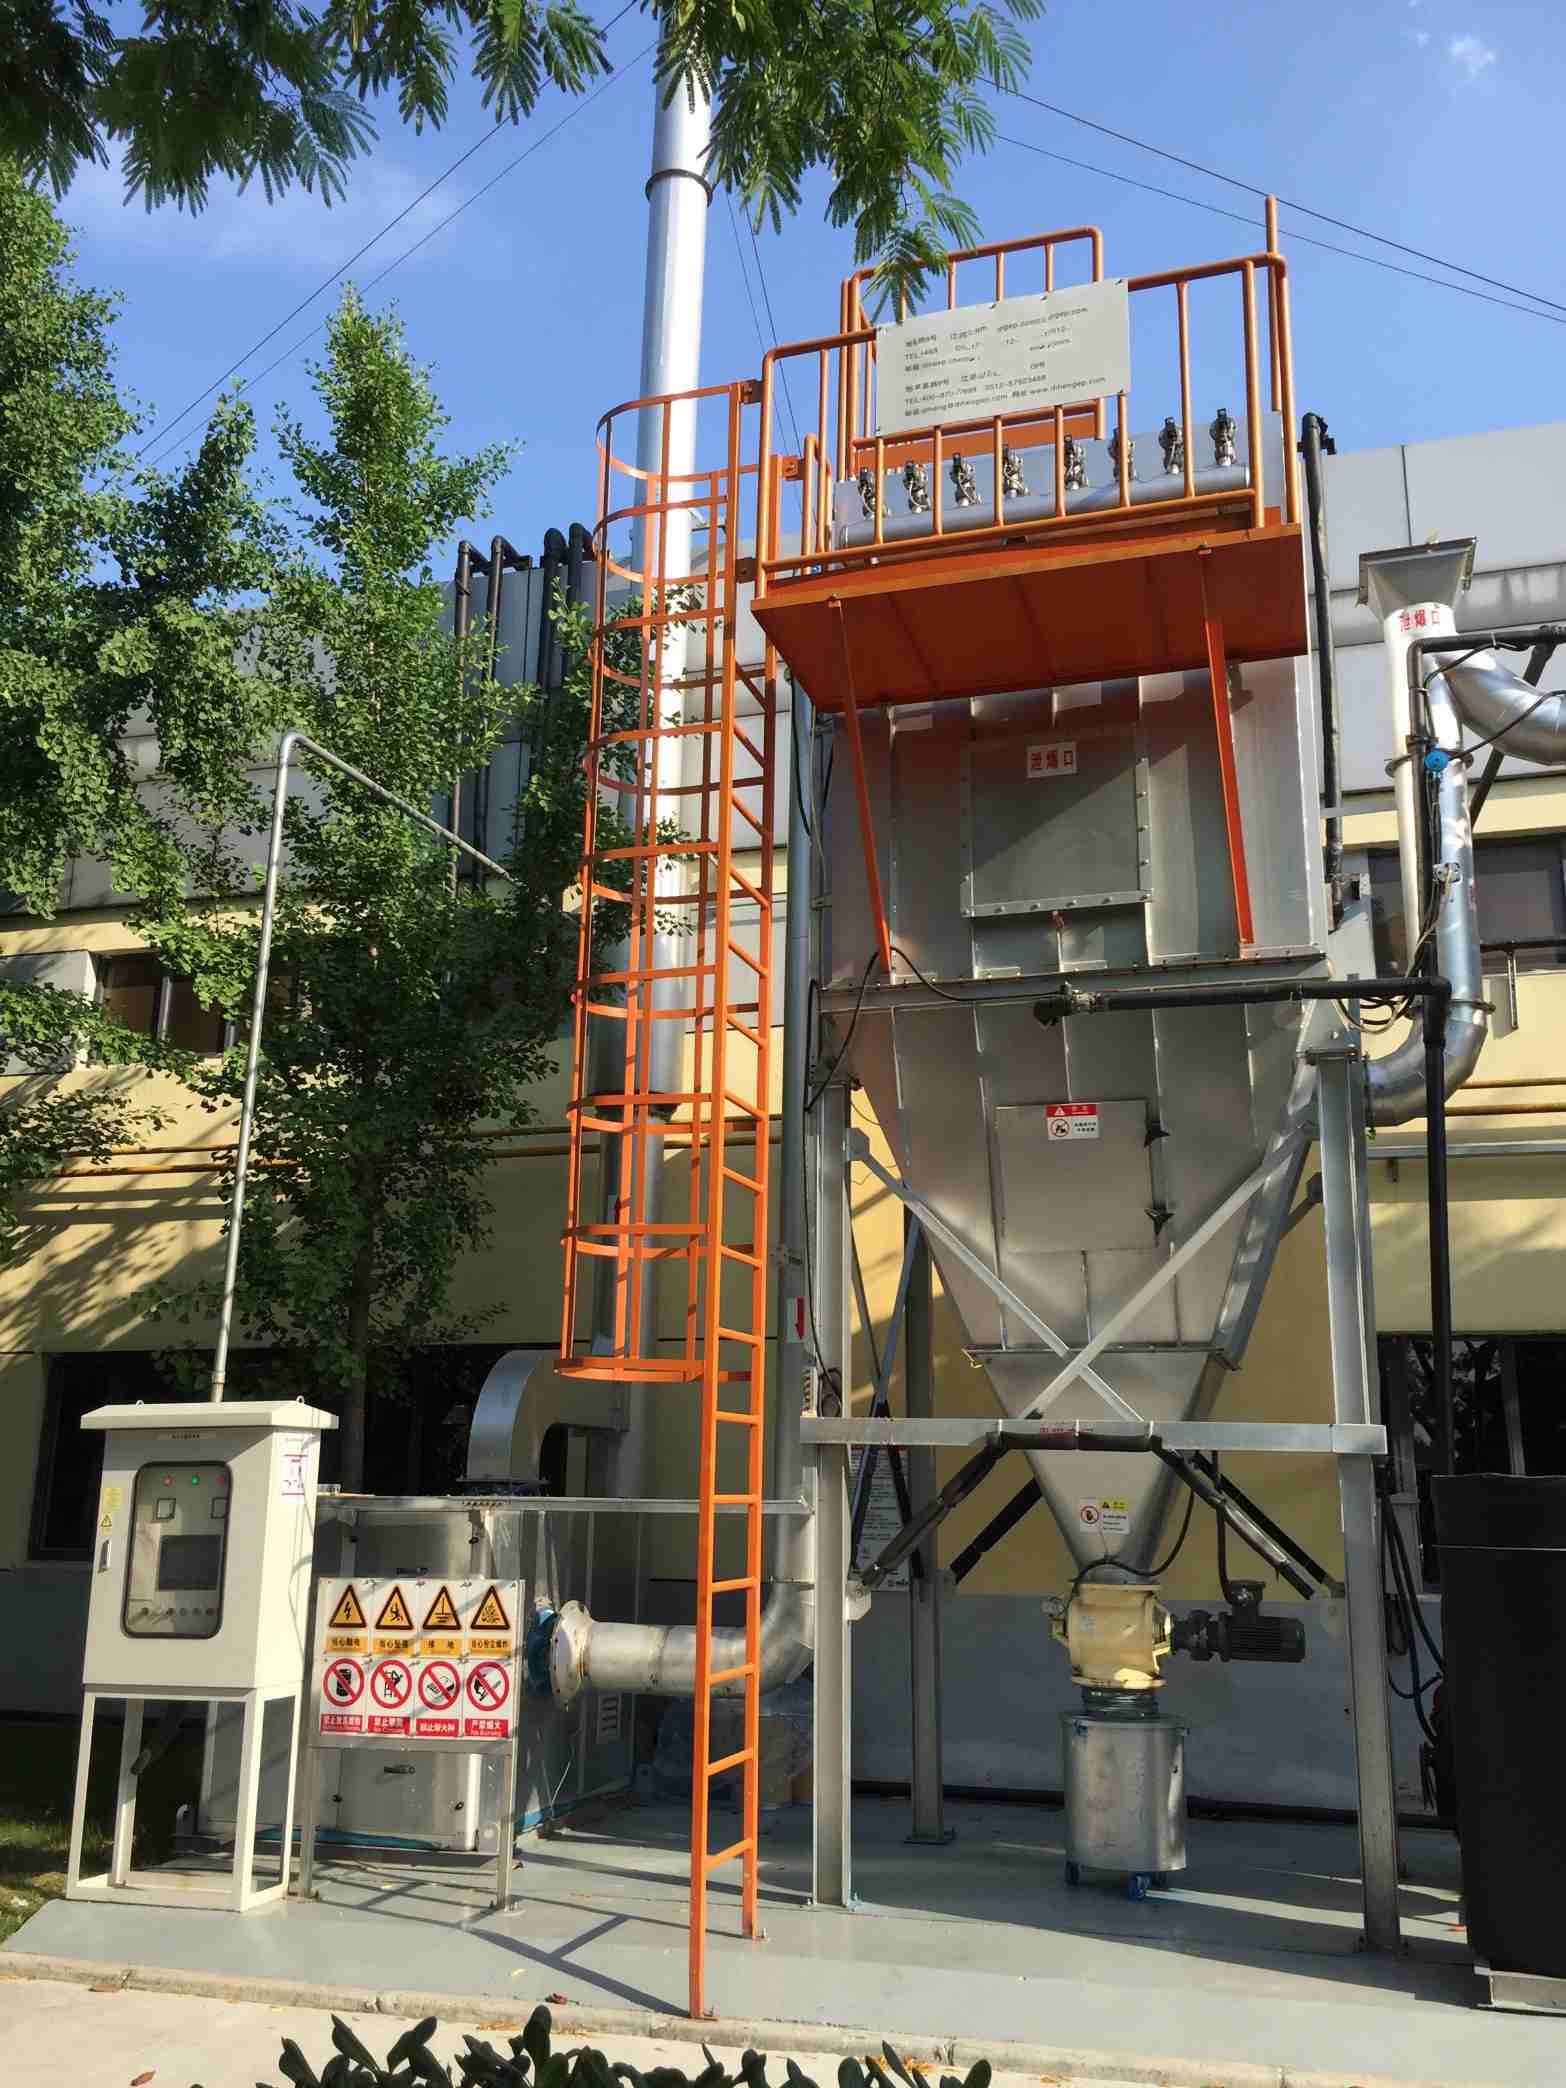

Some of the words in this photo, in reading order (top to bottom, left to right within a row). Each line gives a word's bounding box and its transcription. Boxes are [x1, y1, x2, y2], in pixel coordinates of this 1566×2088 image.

[332, 1637, 361, 1647] 当心触电
[471, 1719, 500, 1729] 严禁烟火
